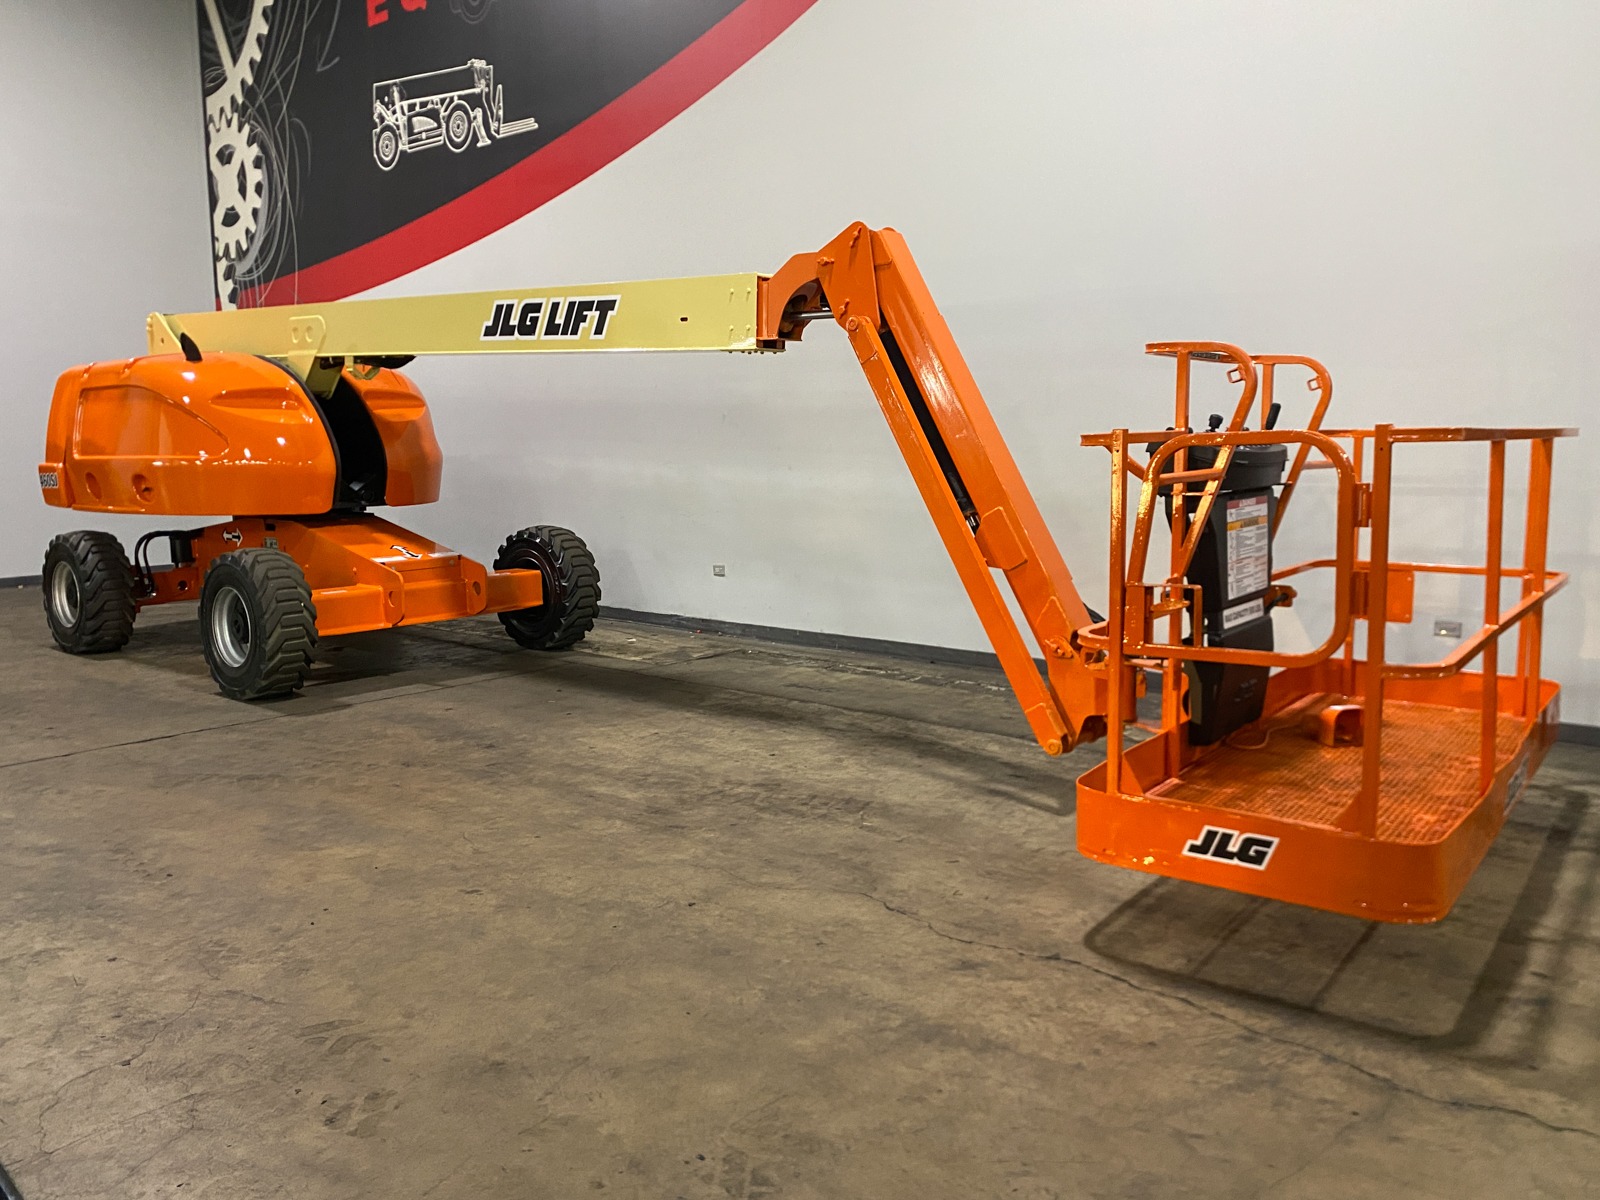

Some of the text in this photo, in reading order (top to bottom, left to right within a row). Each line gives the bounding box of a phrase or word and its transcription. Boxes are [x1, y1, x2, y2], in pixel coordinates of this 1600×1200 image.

[482, 299, 618, 338] JLG LIFT
[1185, 828, 1277, 868] JLG
